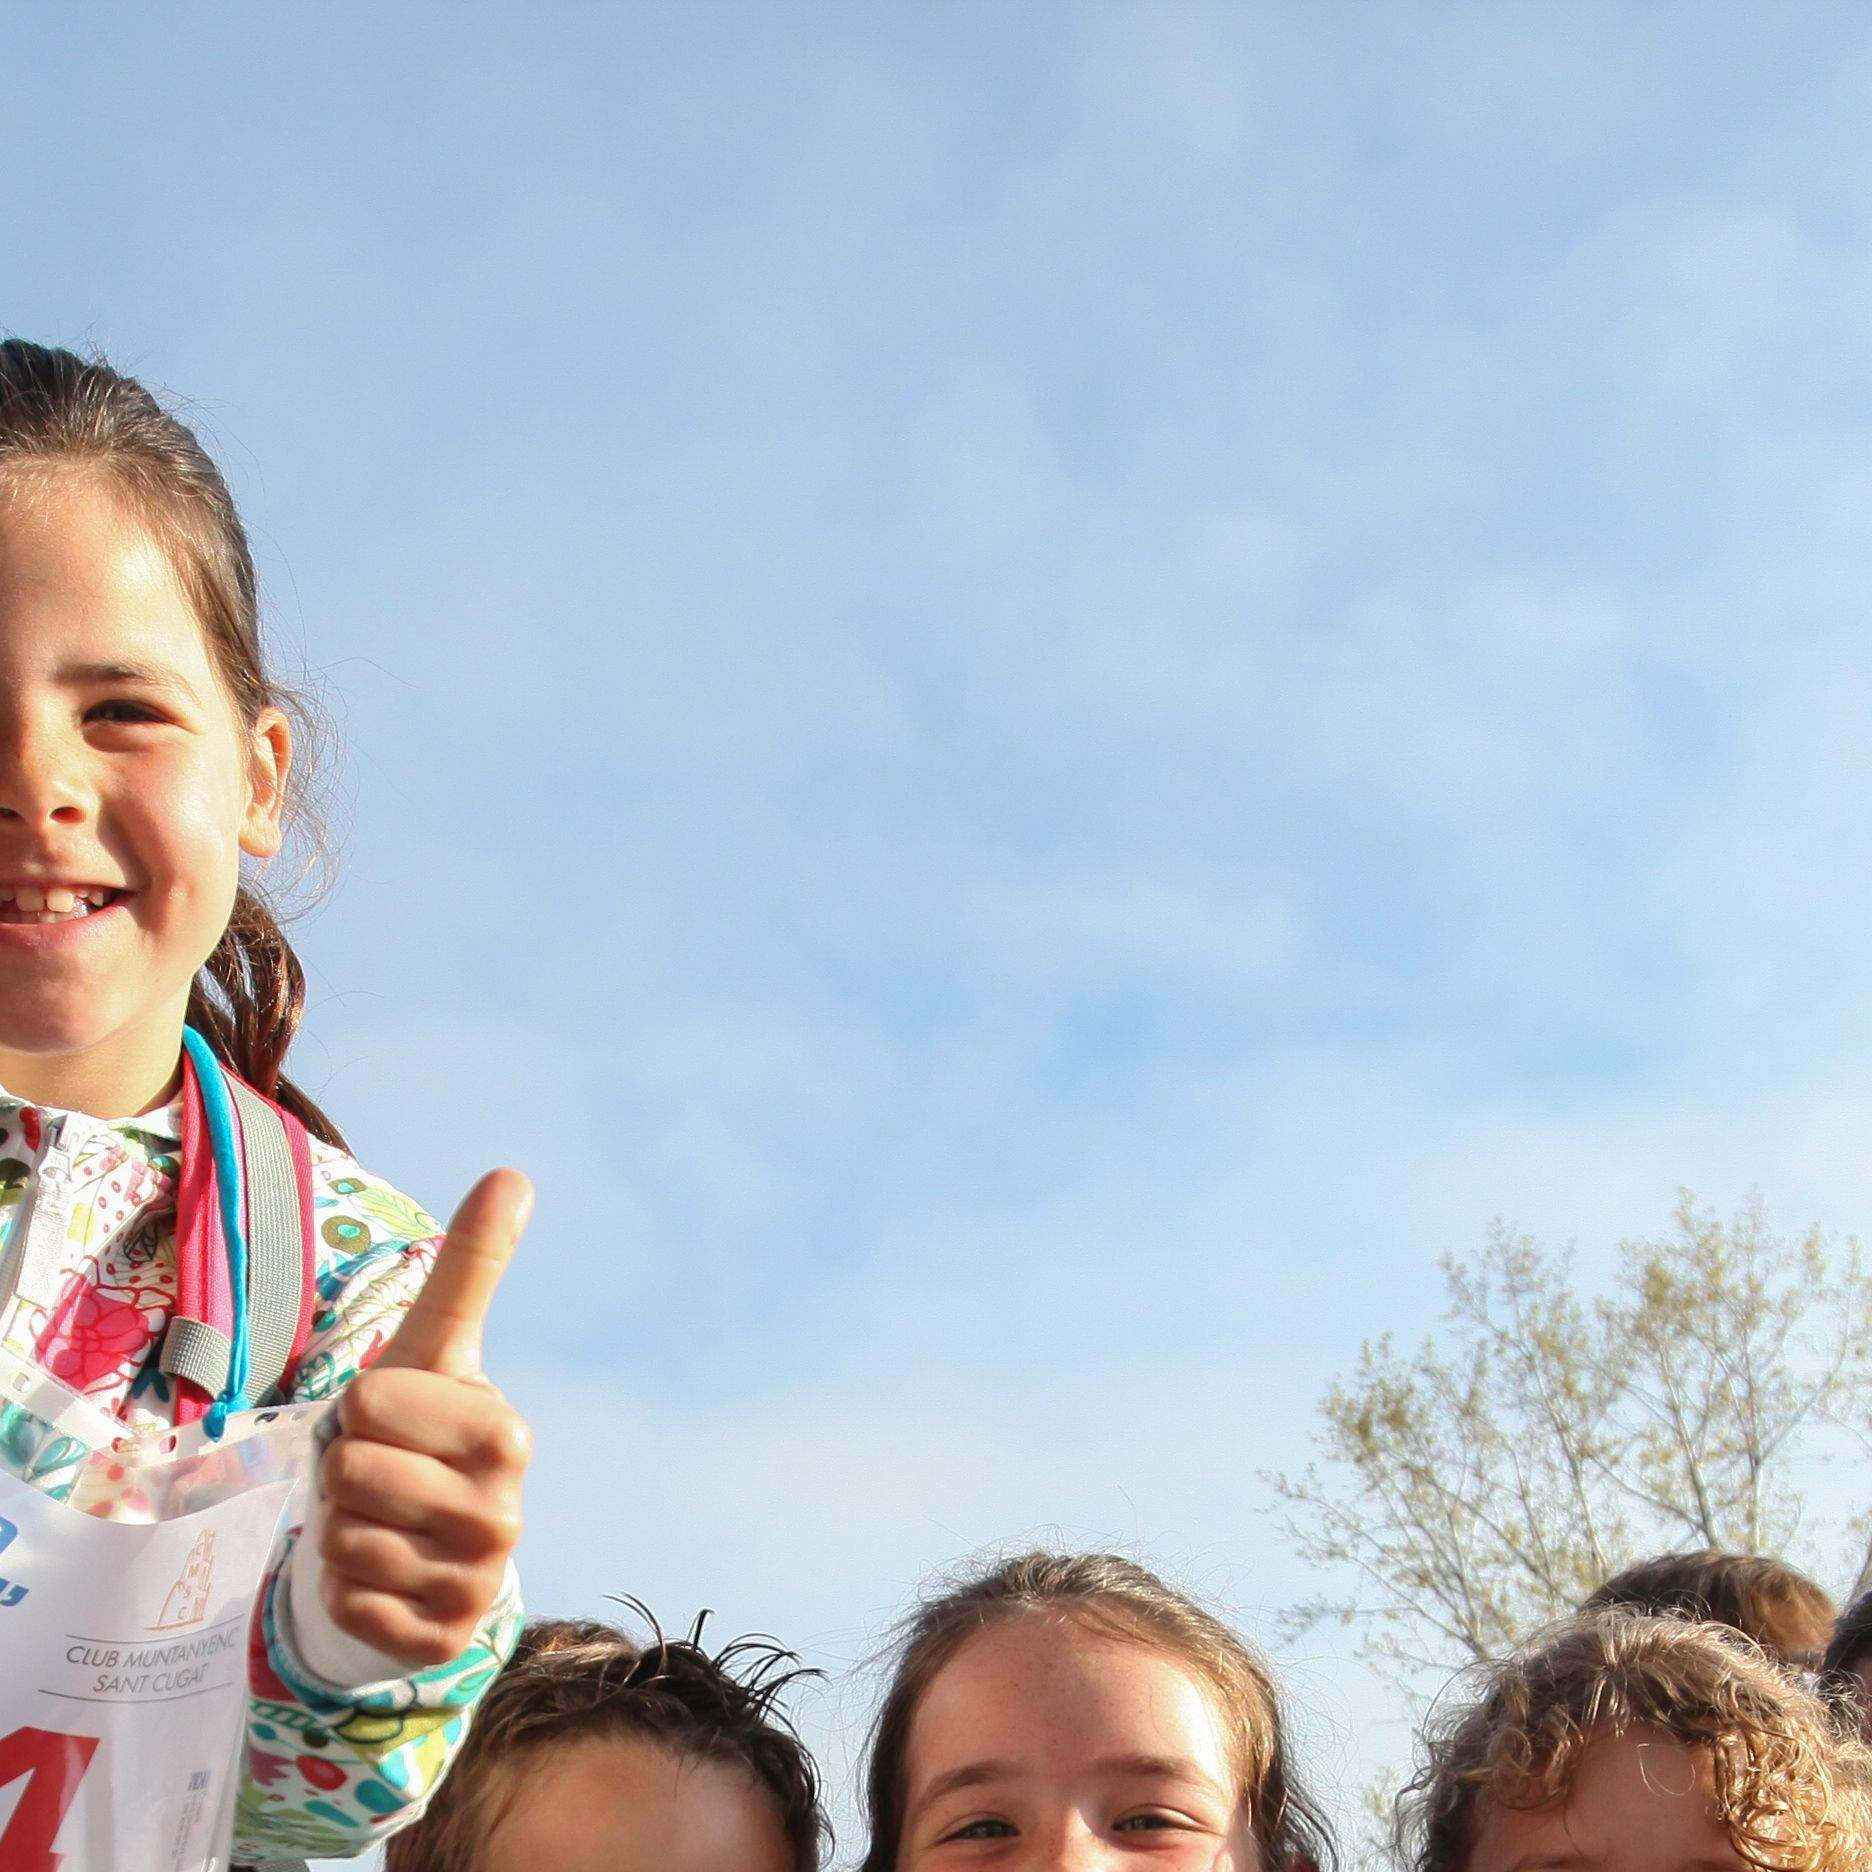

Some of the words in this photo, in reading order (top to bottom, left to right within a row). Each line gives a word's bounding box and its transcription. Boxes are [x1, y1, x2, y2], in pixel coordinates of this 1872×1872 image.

[66, 1645, 119, 1669] CLUB
[123, 1626, 241, 1670] MUNTANYENC
[93, 1672, 149, 1694] SANT
[152, 1663, 209, 1693] CUGAT
